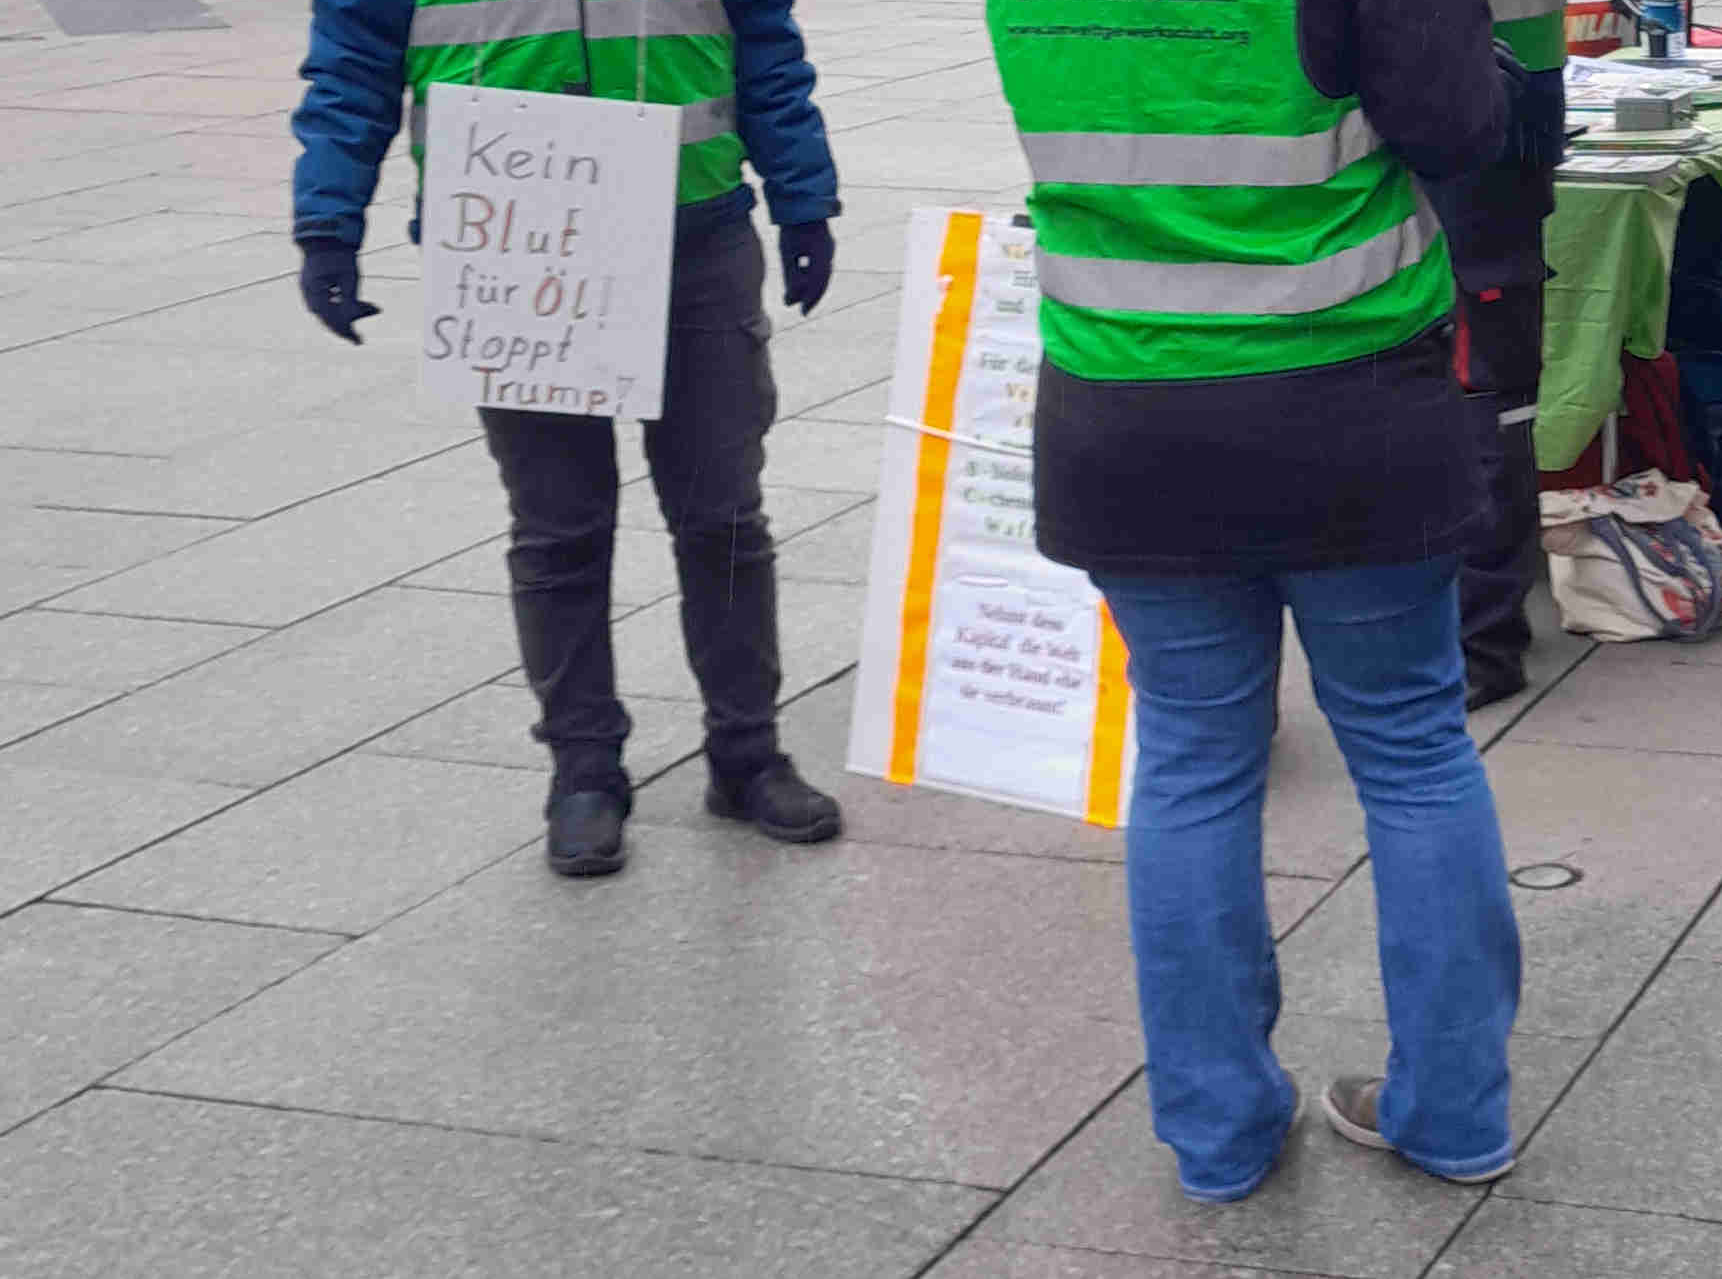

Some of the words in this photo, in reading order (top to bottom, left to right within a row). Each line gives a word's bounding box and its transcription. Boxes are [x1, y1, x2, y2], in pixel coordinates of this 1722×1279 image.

[464, 122, 599, 184] Kein
[441, 192, 583, 257] Blut
[456, 264, 520, 309] für
[425, 315, 574, 373] Stoppt
